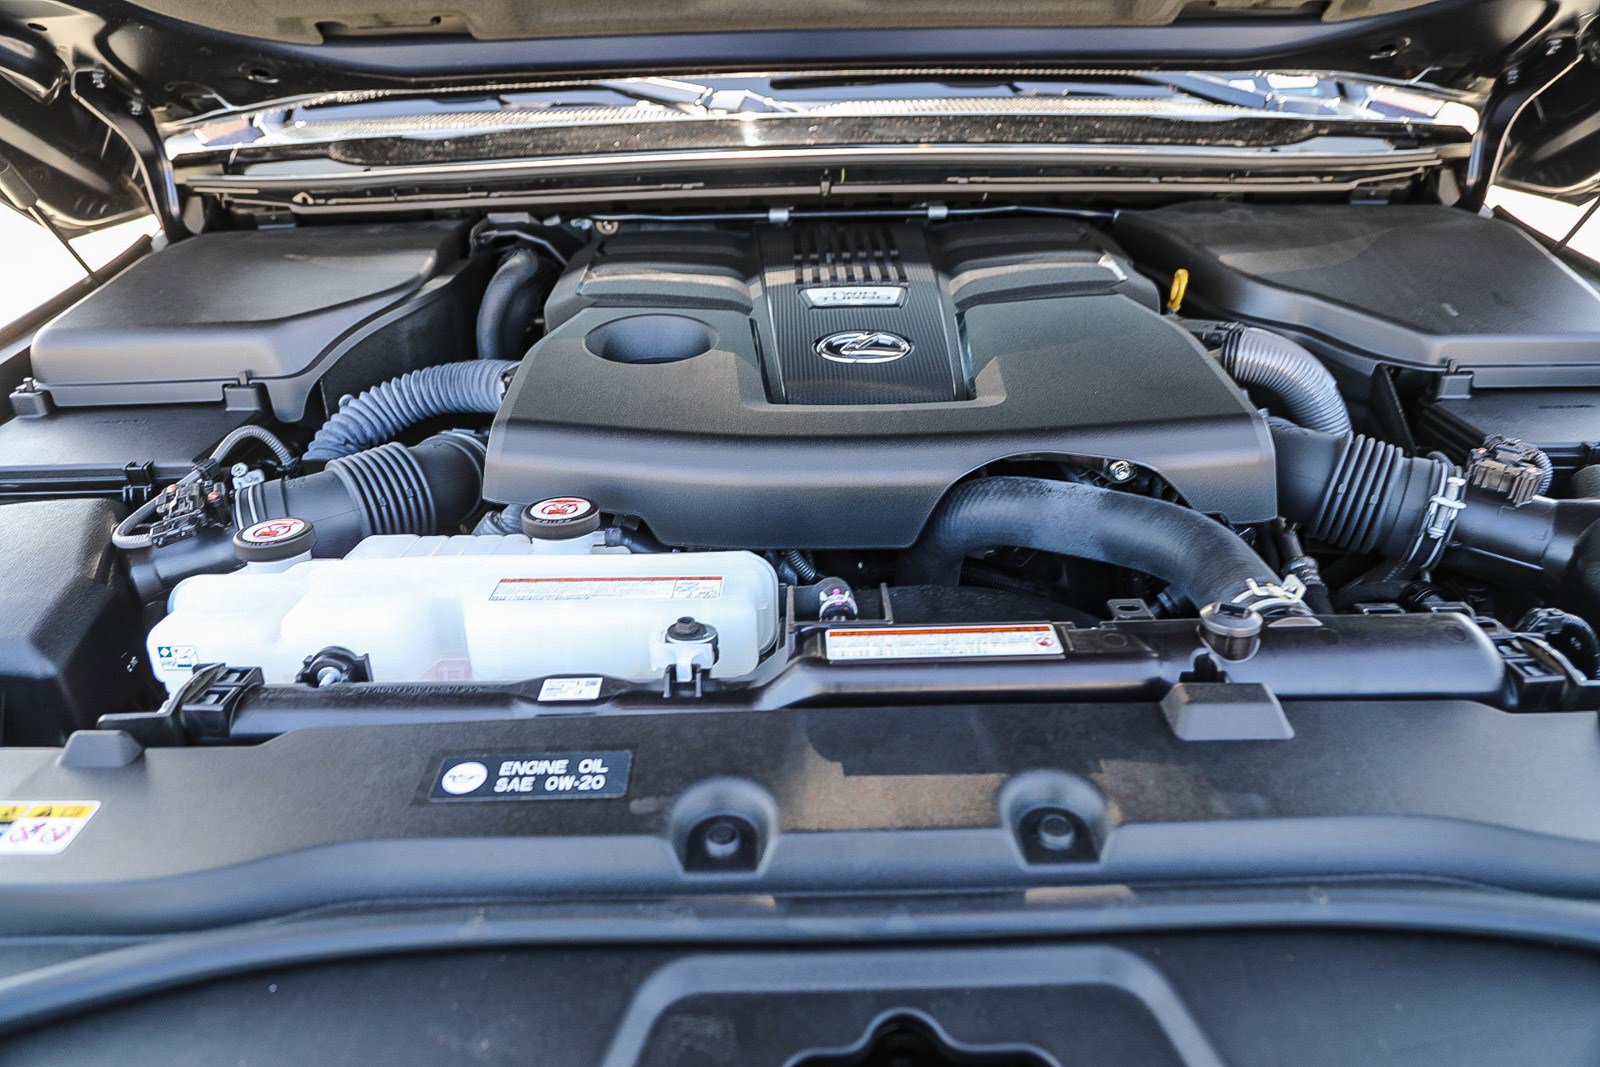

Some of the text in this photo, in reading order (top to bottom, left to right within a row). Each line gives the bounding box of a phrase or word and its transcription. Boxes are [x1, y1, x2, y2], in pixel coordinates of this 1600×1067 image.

[499, 758, 609, 776] ENGINE OIL
[494, 775, 607, 792] SAE 0W-20
